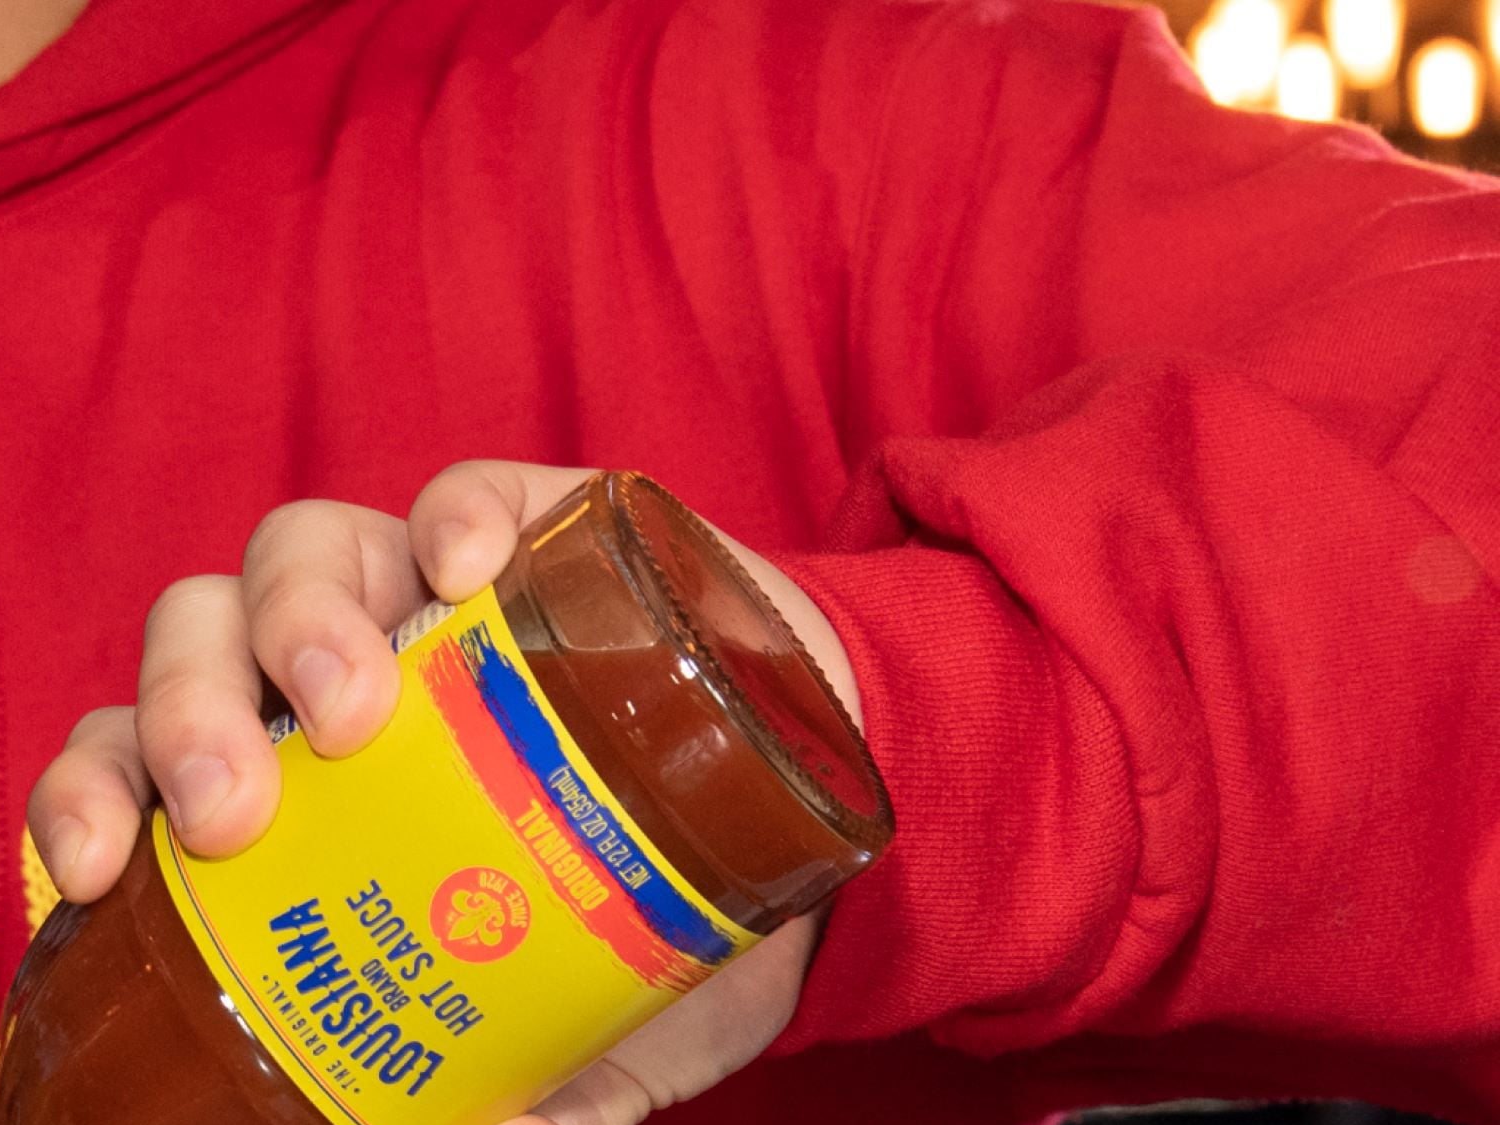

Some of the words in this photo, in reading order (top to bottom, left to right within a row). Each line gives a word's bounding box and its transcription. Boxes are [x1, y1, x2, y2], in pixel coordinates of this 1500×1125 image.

[580, 812, 608, 838] OZ
[596, 829, 621, 854] FL
[516, 798, 610, 911] ORIGINAL
[607, 844, 633, 867] 12
[618, 861, 652, 890] NET
[345, 879, 435, 981] SAUCE
[504, 889, 528, 928] SINCE
[269, 897, 445, 1097] LOUISIANA
[360, 958, 411, 1012] BRAND
[266, 981, 328, 1056] ORIGINAL
[419, 980, 485, 1037] HOT
[326, 1059, 357, 1091] THE
